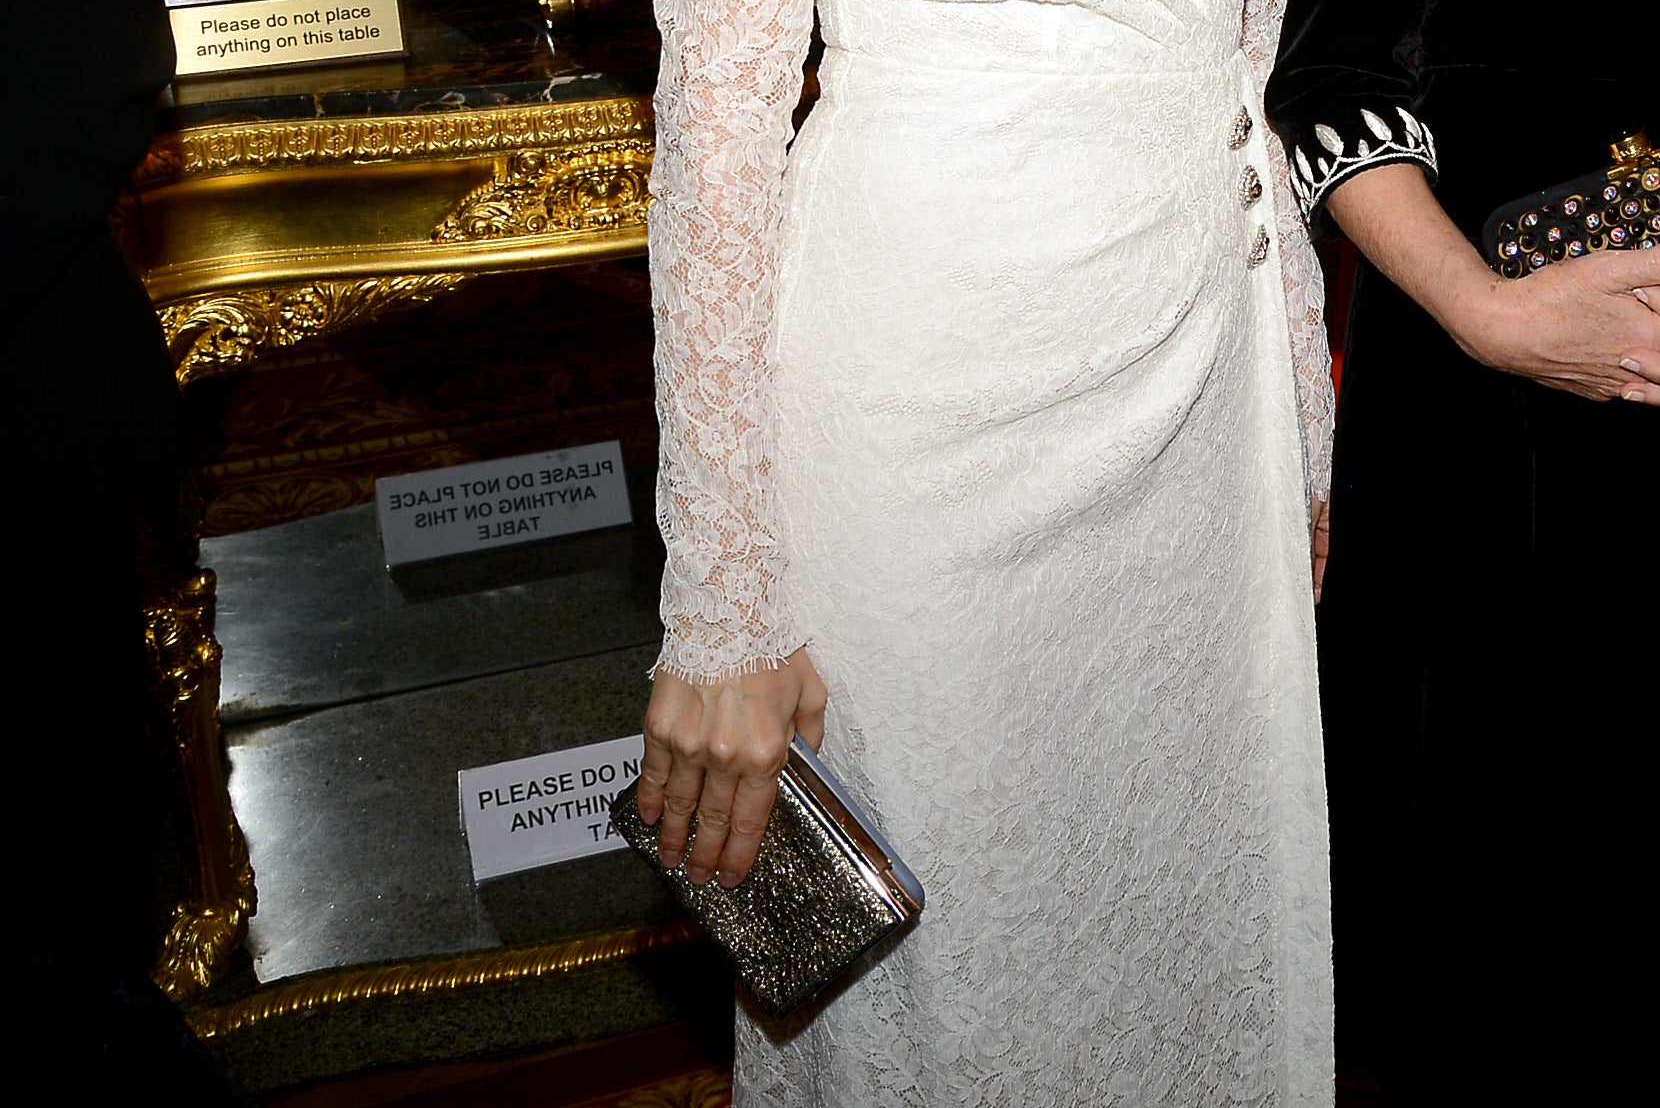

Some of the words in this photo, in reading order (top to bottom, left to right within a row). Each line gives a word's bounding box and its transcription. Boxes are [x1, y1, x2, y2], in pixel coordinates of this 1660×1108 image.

[200, 17, 261, 34] Please
[266, 13, 288, 28] do
[293, 10, 321, 25] not
[325, 6, 371, 25] place
[196, 37, 271, 58] anything
[276, 34, 298, 48] on
[303, 30, 333, 45] this
[338, 25, 380, 42] table
[478, 772, 575, 810] PLEASE
[581, 764, 616, 788] DO
